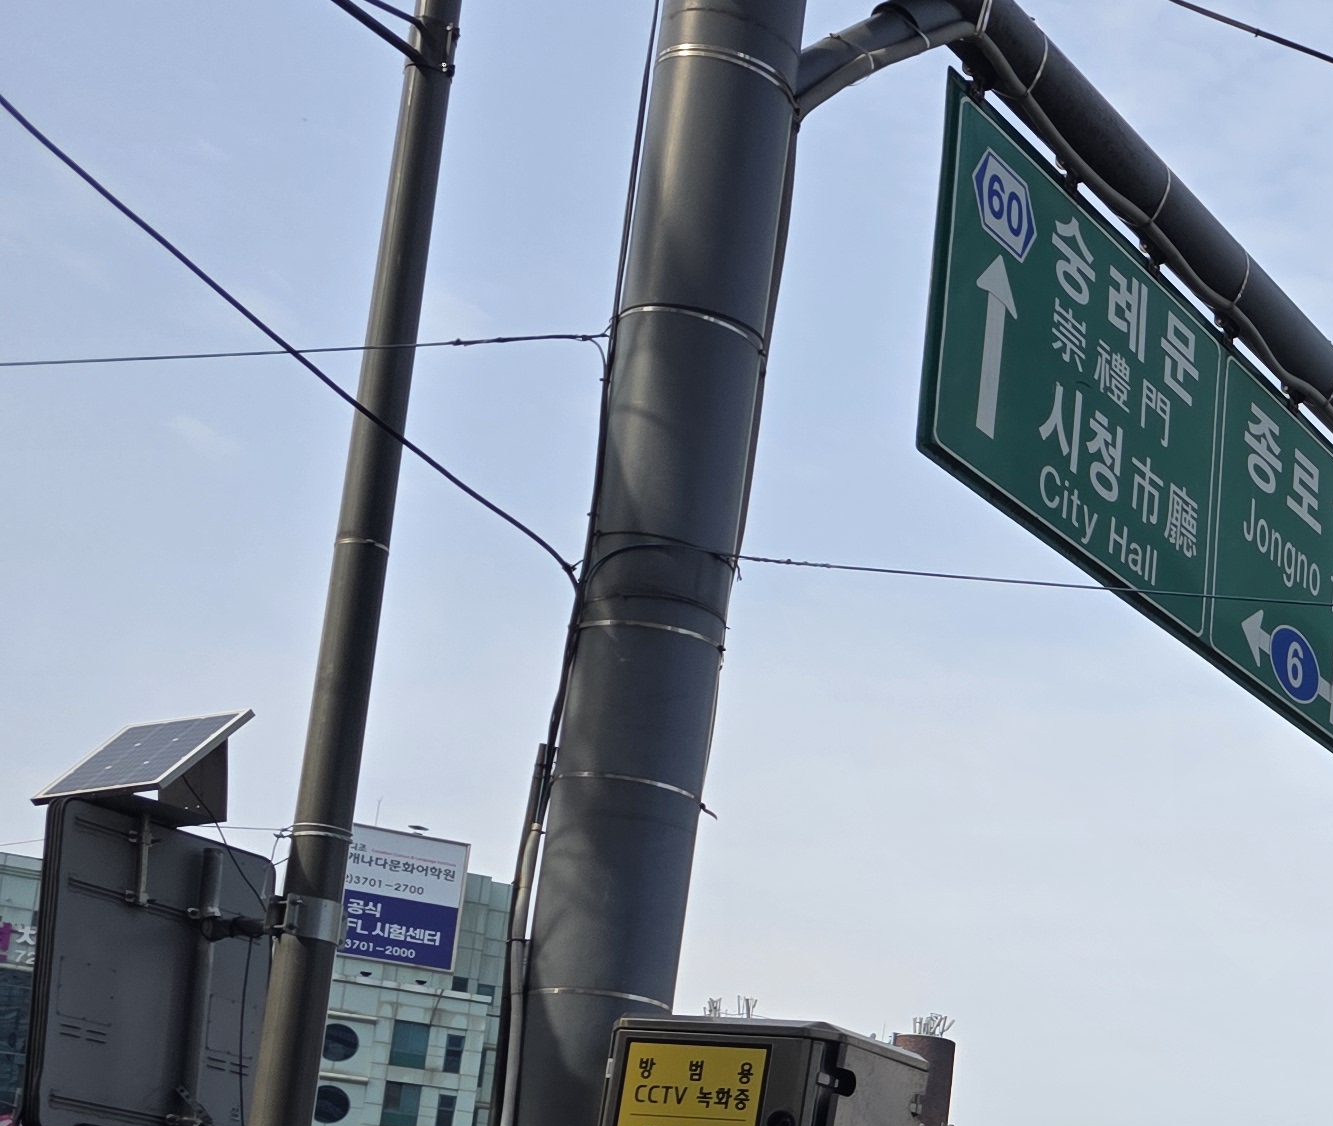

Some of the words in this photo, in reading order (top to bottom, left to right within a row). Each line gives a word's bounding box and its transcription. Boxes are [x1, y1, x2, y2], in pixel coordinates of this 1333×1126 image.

[988, 174, 1023, 237] 60
[1052, 217, 1199, 407] 숭례문
[1052, 298, 1171, 447] 崇禮門
[1040, 465, 1098, 544] City
[1109, 516, 1158, 586] Hall
[1243, 498, 1320, 596] Jongno
[1286, 641, 1303, 688] 6
[347, 898, 382, 917] 공식
[371, 921, 441, 946] 시험센터
[344, 938, 416, 958] 3701-2000
[634, 1084, 688, 1105] CCTV
[696, 1086, 750, 1111] 녹화중
